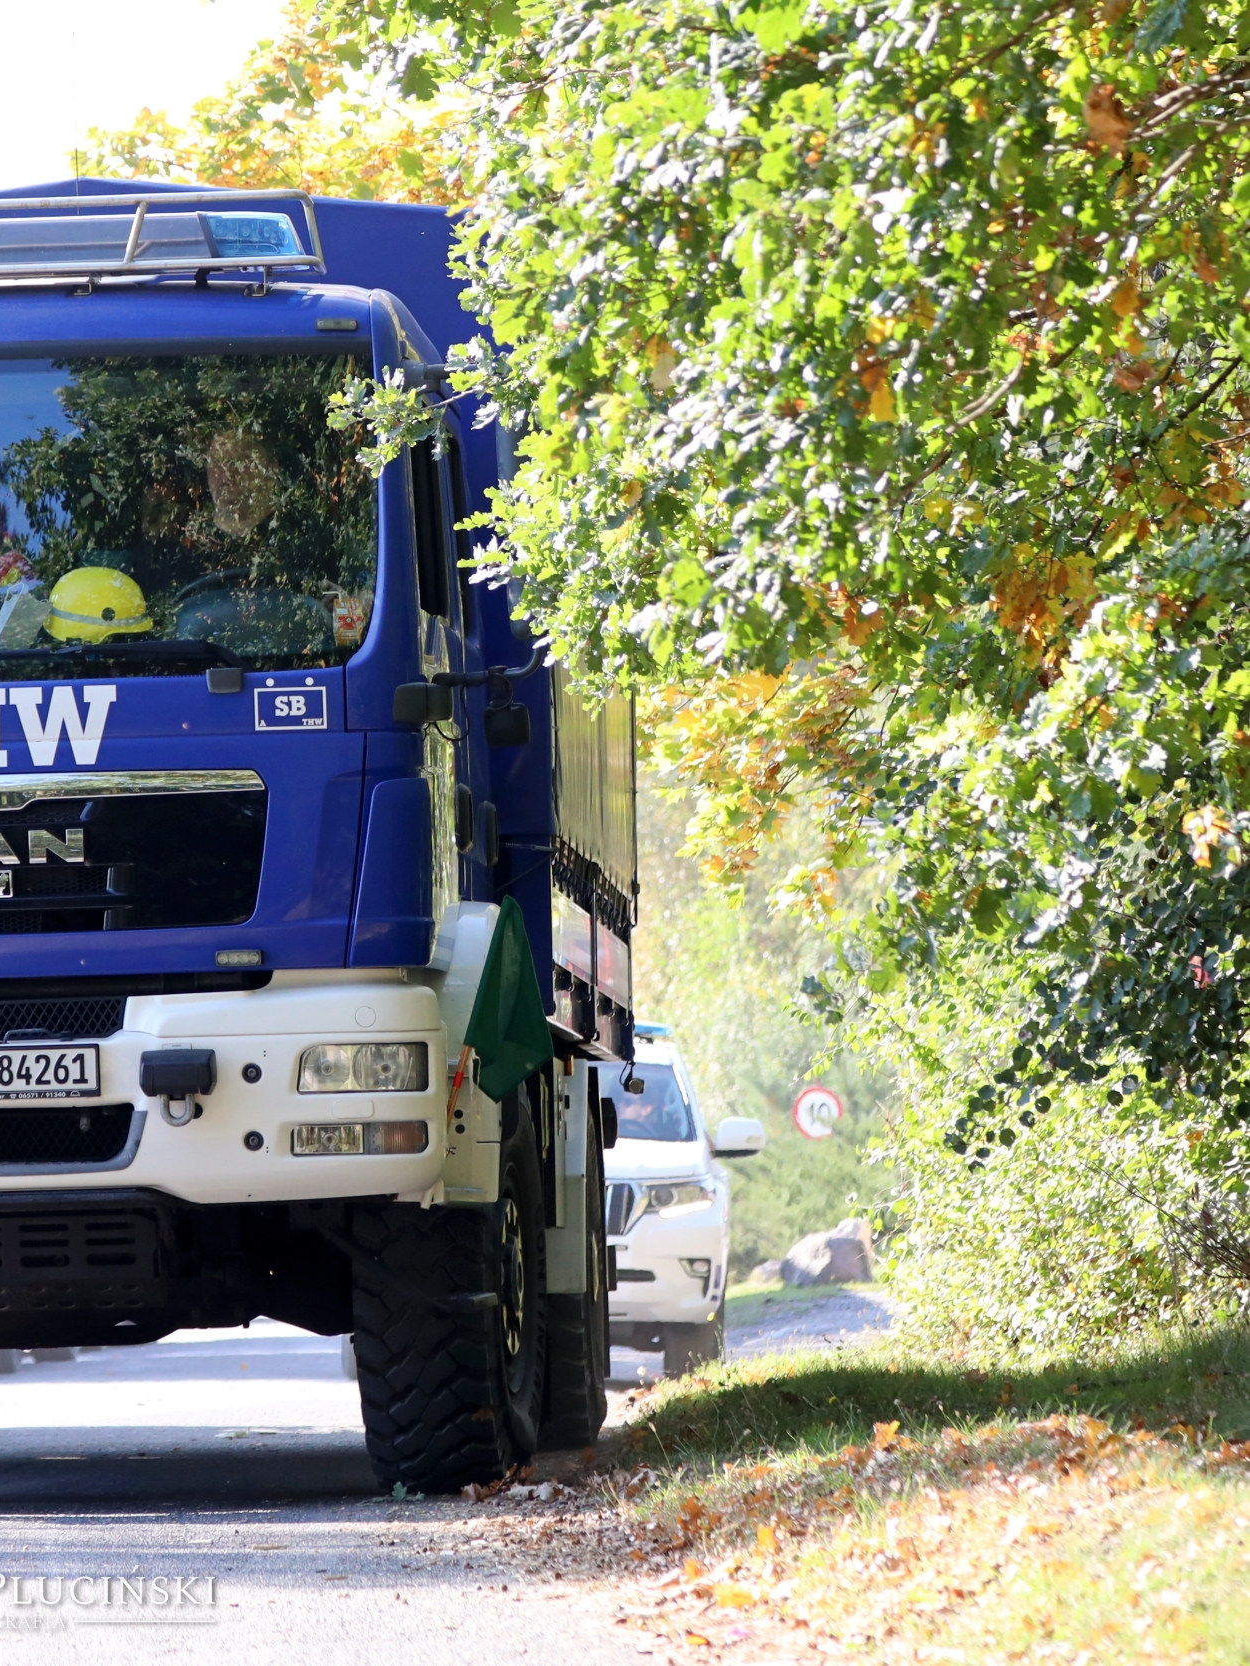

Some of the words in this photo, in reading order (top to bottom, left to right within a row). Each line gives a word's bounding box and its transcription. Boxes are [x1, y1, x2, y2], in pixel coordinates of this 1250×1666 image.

[274, 695, 307, 717] SB
[259, 719, 267, 727] A
[301, 718, 323, 726] THW
